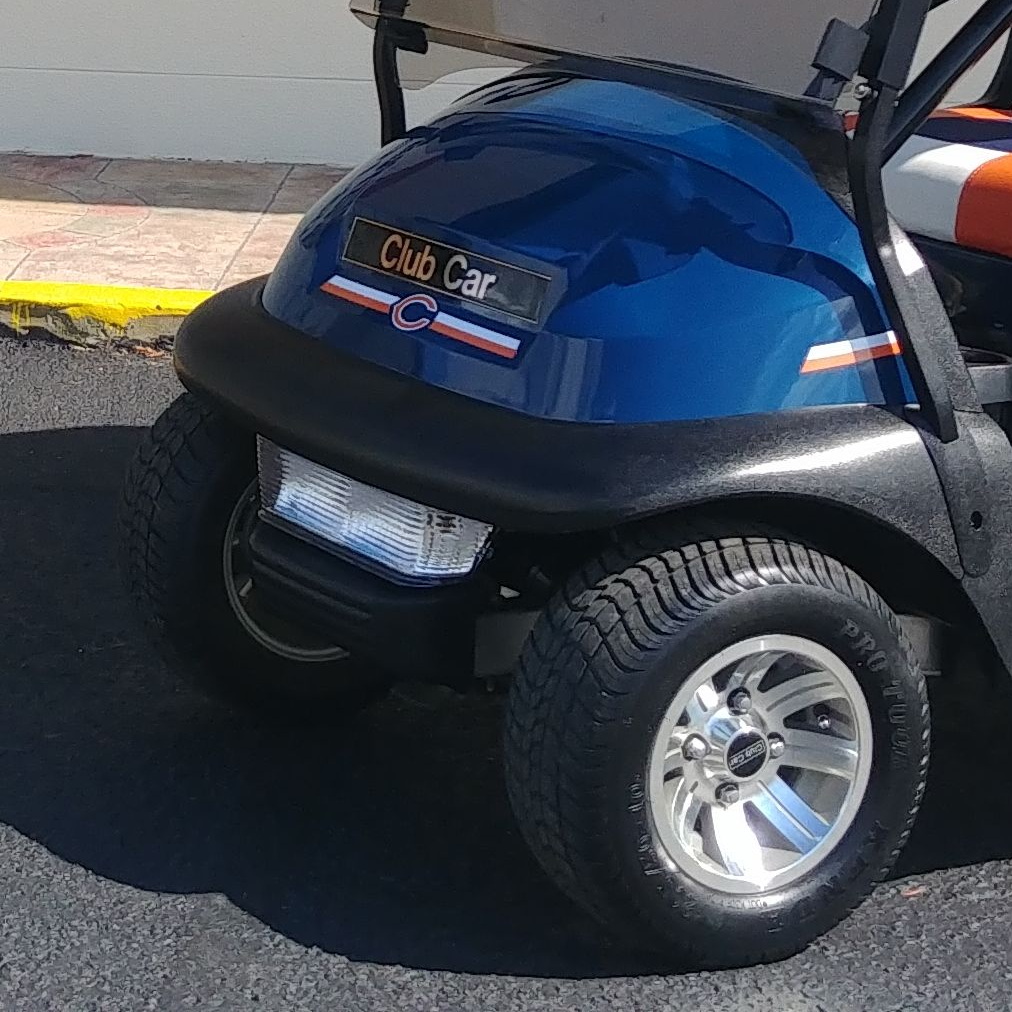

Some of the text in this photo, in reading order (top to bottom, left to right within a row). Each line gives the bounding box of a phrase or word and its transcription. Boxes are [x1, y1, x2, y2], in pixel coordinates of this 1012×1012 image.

[380, 233, 497, 301] Club Car
[391, 293, 438, 331] C
